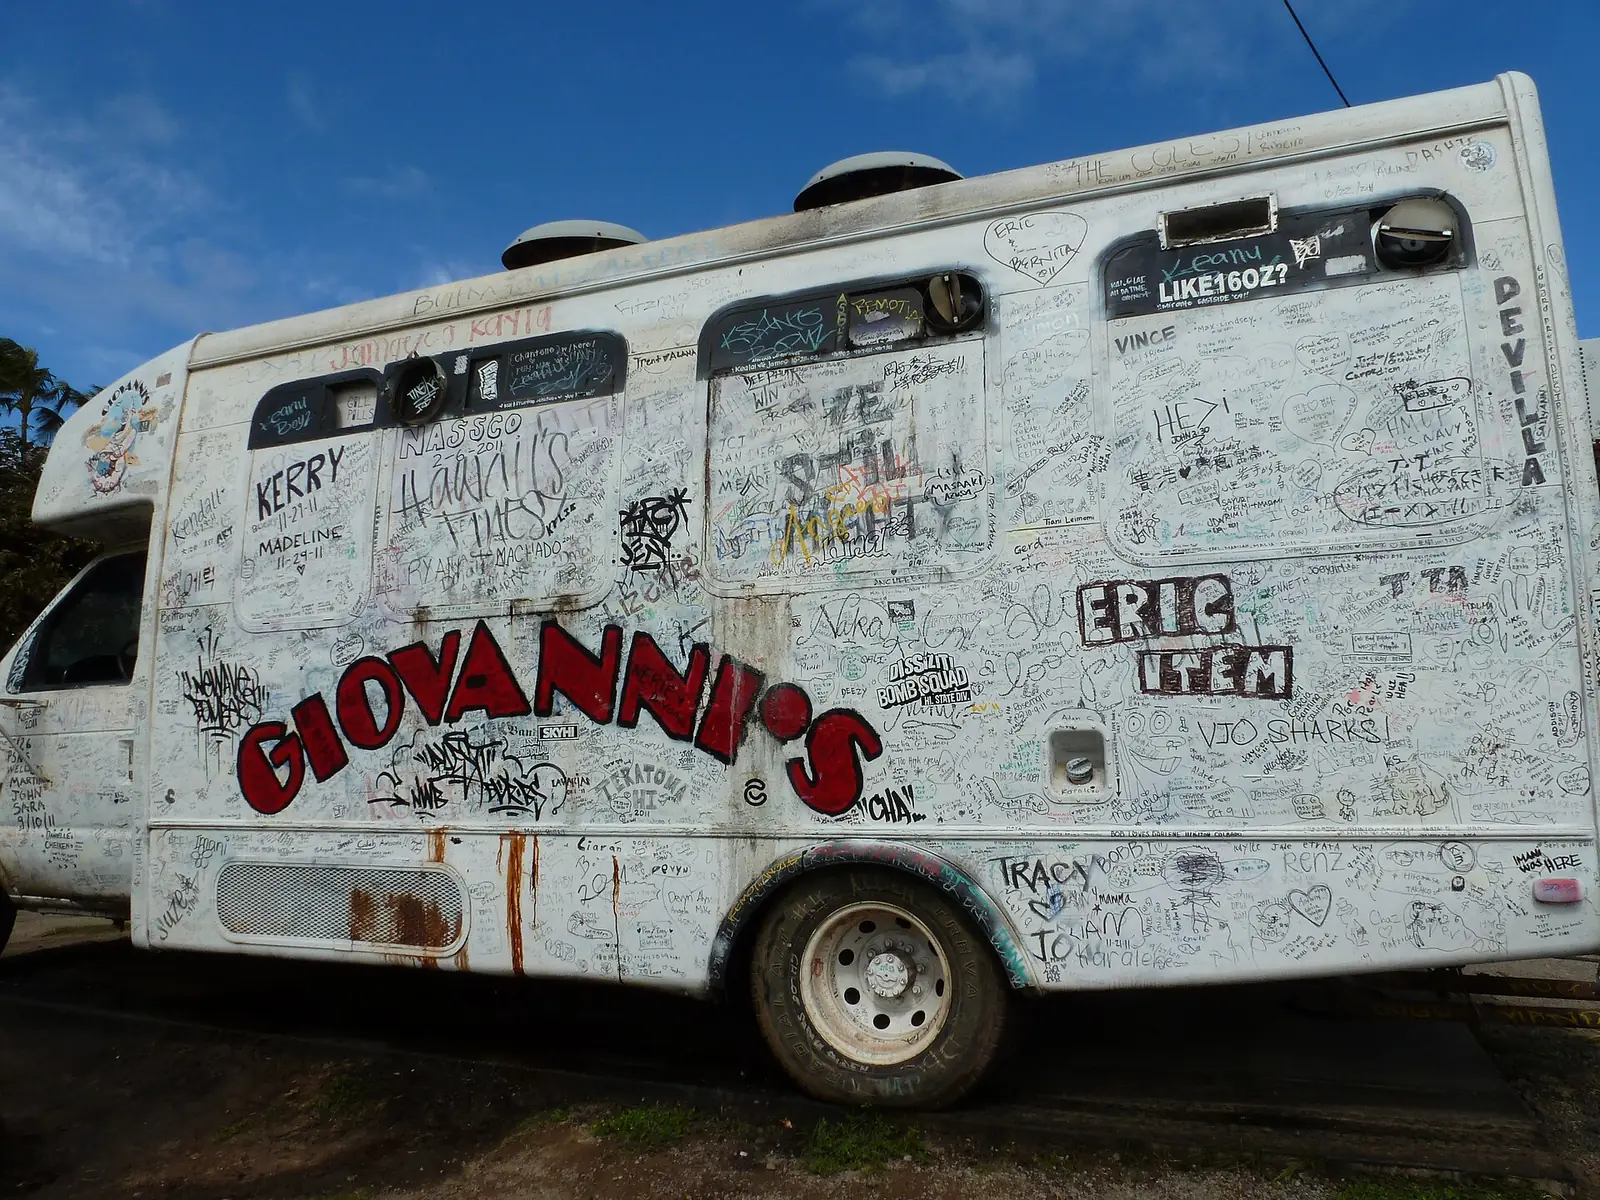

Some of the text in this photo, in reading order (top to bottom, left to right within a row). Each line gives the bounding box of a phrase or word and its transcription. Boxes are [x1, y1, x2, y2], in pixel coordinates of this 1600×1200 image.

[994, 217, 1035, 240] ERIC
[1009, 244, 1080, 272] BERNITA
[1115, 325, 1177, 355] VINCE
[634, 356, 662, 370] Trent
[399, 413, 523, 459] NASSCO
[256, 444, 345, 521] KERRY
[930, 475, 984, 496] MASAAKI
[259, 524, 344, 557] MADELINE
[494, 540, 562, 568] MACHADO
[276, 545, 324, 571] 11-29-11
[1077, 572, 1236, 648] ERIC
[1137, 643, 1294, 702] ITEM
[841, 687, 867, 697] DEEZY
[876, 664, 969, 710] BOMB SQUAD
[935, 692, 956, 704] STATE
[236, 618, 884, 816] GIOVANNI'S
[1266, 715, 1390, 746] SHARKS!
[541, 725, 577, 740] SKYHI
[13, 801, 46, 815] SARA
[633, 809, 651, 818] 2011
[989, 853, 1099, 893] TRACY
[1544, 854, 1583, 874] HERE
